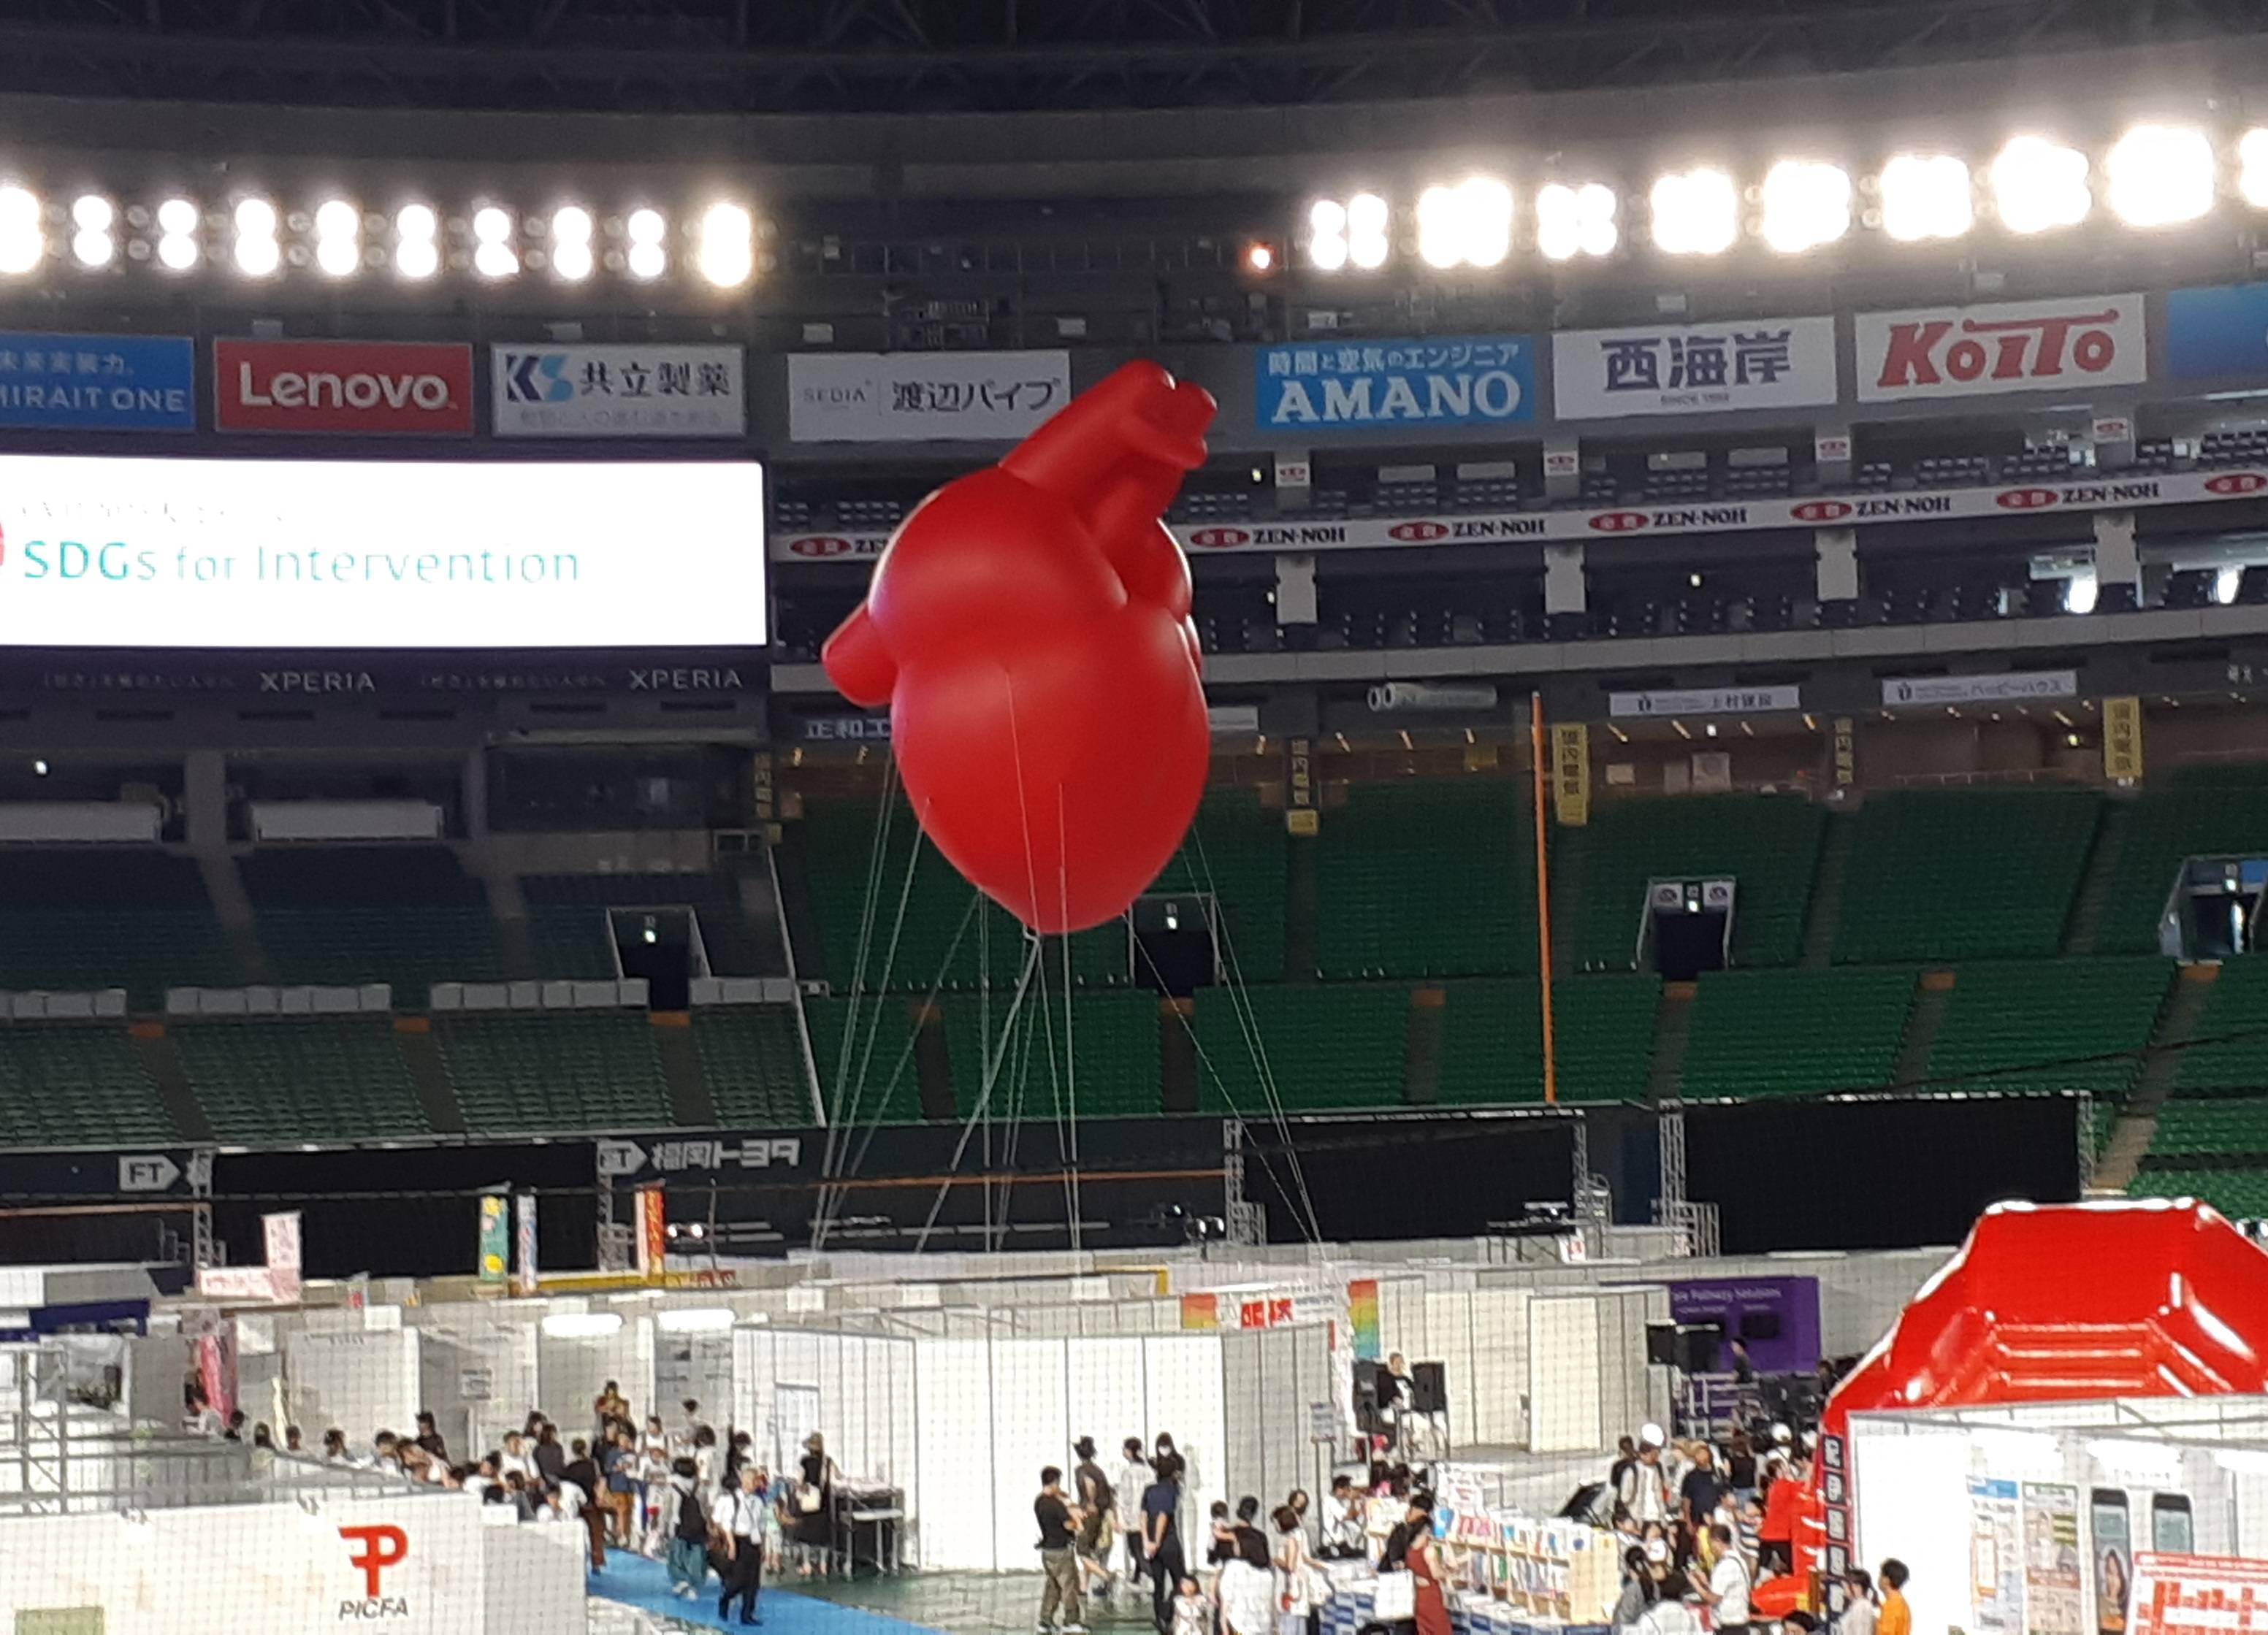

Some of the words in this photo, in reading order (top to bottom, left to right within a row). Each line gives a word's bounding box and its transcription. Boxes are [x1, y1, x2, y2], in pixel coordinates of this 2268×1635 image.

[1268, 343, 1519, 377] 時間と空気のエンジニア
[1600, 330, 1792, 391] 西海岸
[240, 361, 449, 410] Lenovo
[580, 361, 730, 397] 共立製薬
[893, 378, 1061, 412] 渡辺パイプ
[112, 388, 186, 413] ONE
[1271, 370, 1521, 423] AMANO
[24, 540, 156, 581] SDGs
[177, 546, 235, 581] for
[258, 544, 579, 583] Intervention
[260, 670, 377, 693] XPERIA
[630, 668, 744, 690] XPERIA
[129, 1161, 164, 1184] FT
[338, 1597, 409, 1621] PICFA
